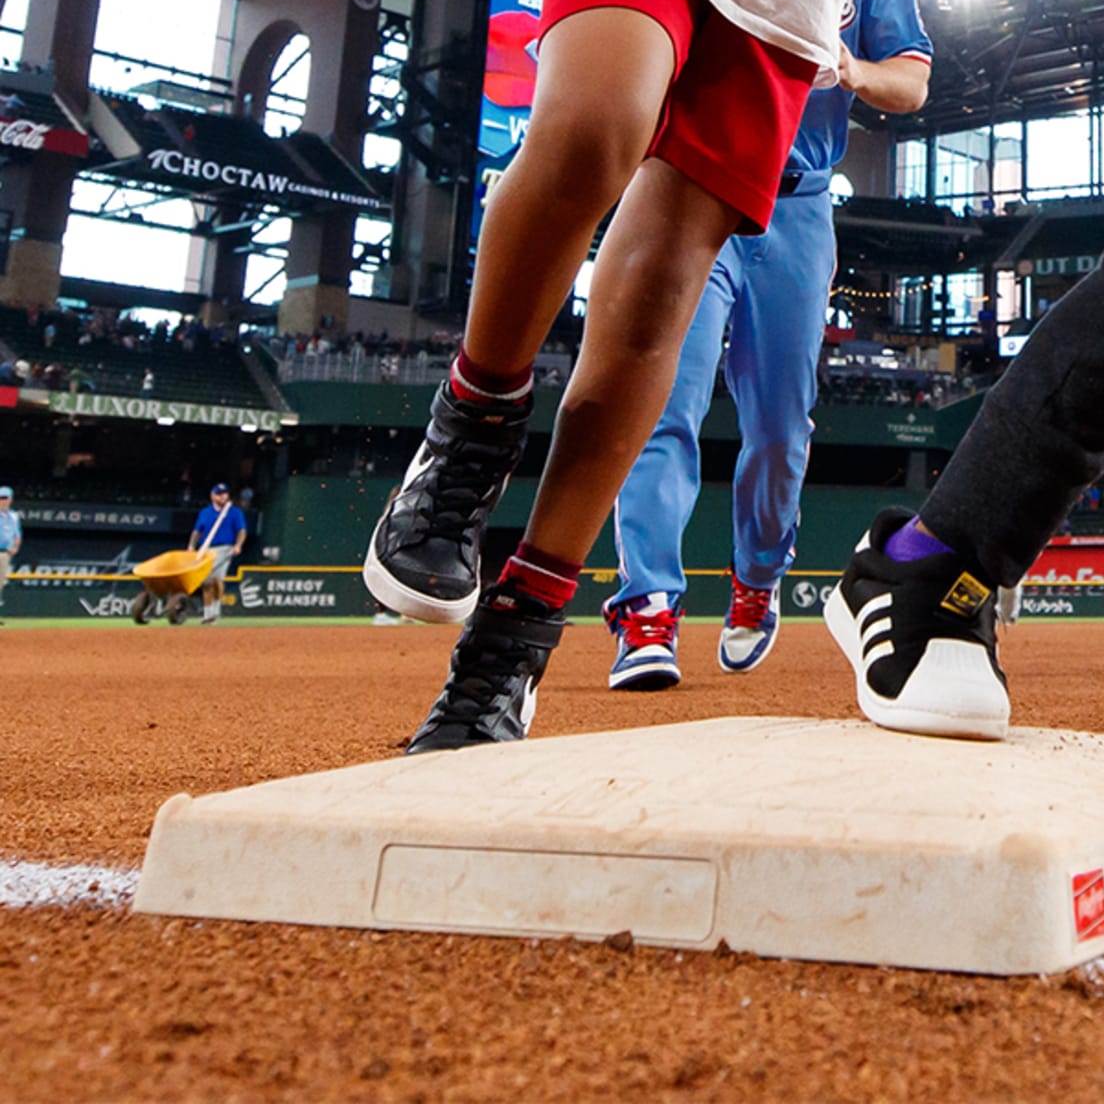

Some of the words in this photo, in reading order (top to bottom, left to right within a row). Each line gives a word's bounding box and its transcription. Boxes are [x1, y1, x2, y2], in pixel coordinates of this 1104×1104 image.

[163, 151, 289, 194] CHOCTAW
[76, 393, 160, 419] LUXOR
[167, 402, 280, 431] STAFFING
[267, 579, 325, 592] ENERGY
[267, 594, 336, 607] TRANSFER
[1022, 598, 1074, 614] Kubota
